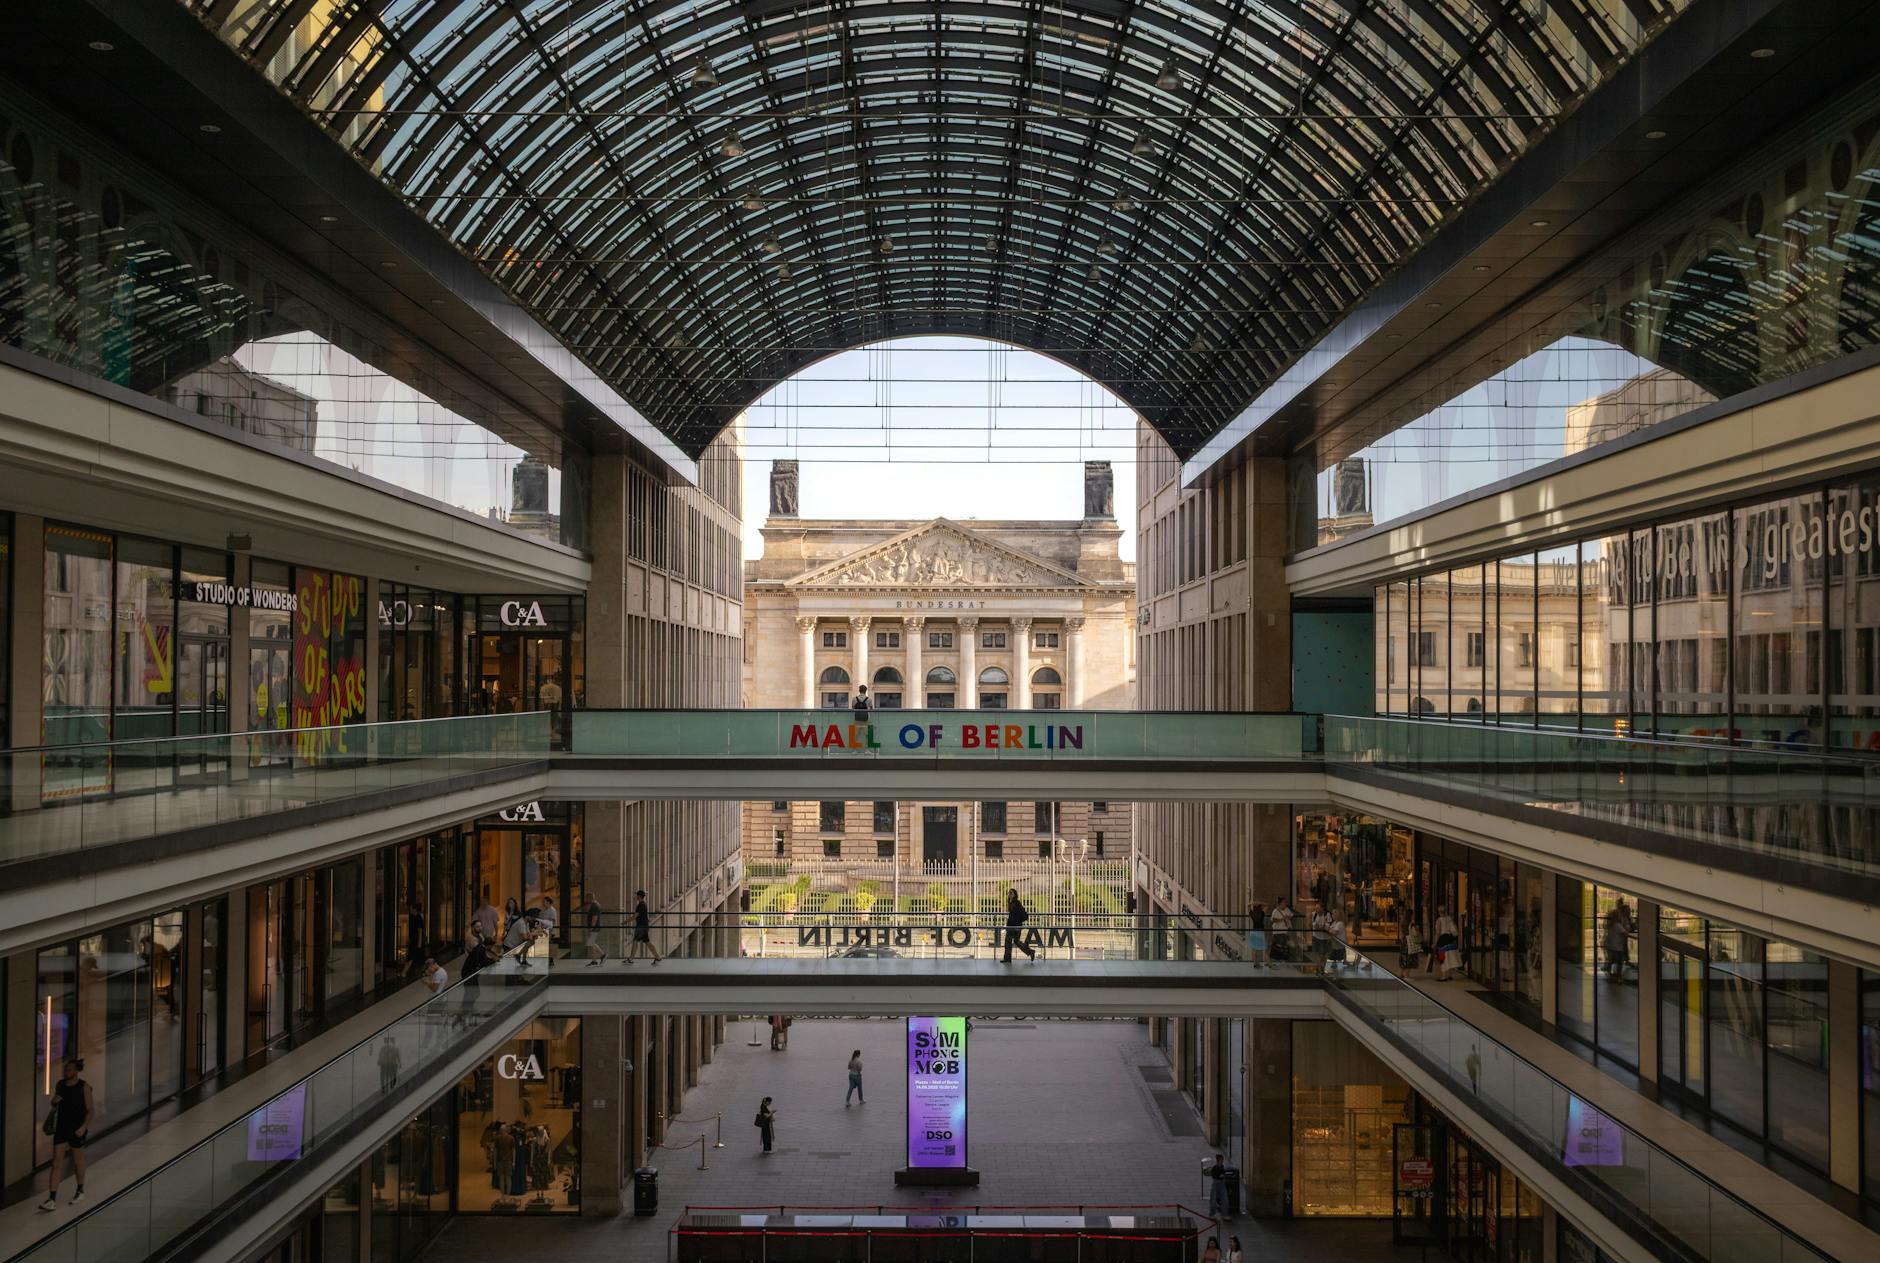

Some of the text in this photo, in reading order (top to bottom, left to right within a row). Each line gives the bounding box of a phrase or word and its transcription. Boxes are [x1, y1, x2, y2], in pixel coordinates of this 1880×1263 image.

[196, 582, 298, 611] STUDIO OF WONDERS
[301, 574, 359, 639] STUDIO
[896, 601, 985, 609] BUNDESRAT
[500, 600, 547, 627] C&A
[304, 643, 327, 695] OF
[790, 723, 1083, 749] MALL OF BERLIN
[915, 1026, 960, 1047] SYM
[497, 1053, 545, 1079] C&A
[914, 1060, 960, 1075] MOB
[926, 1130, 953, 1140] DSO
